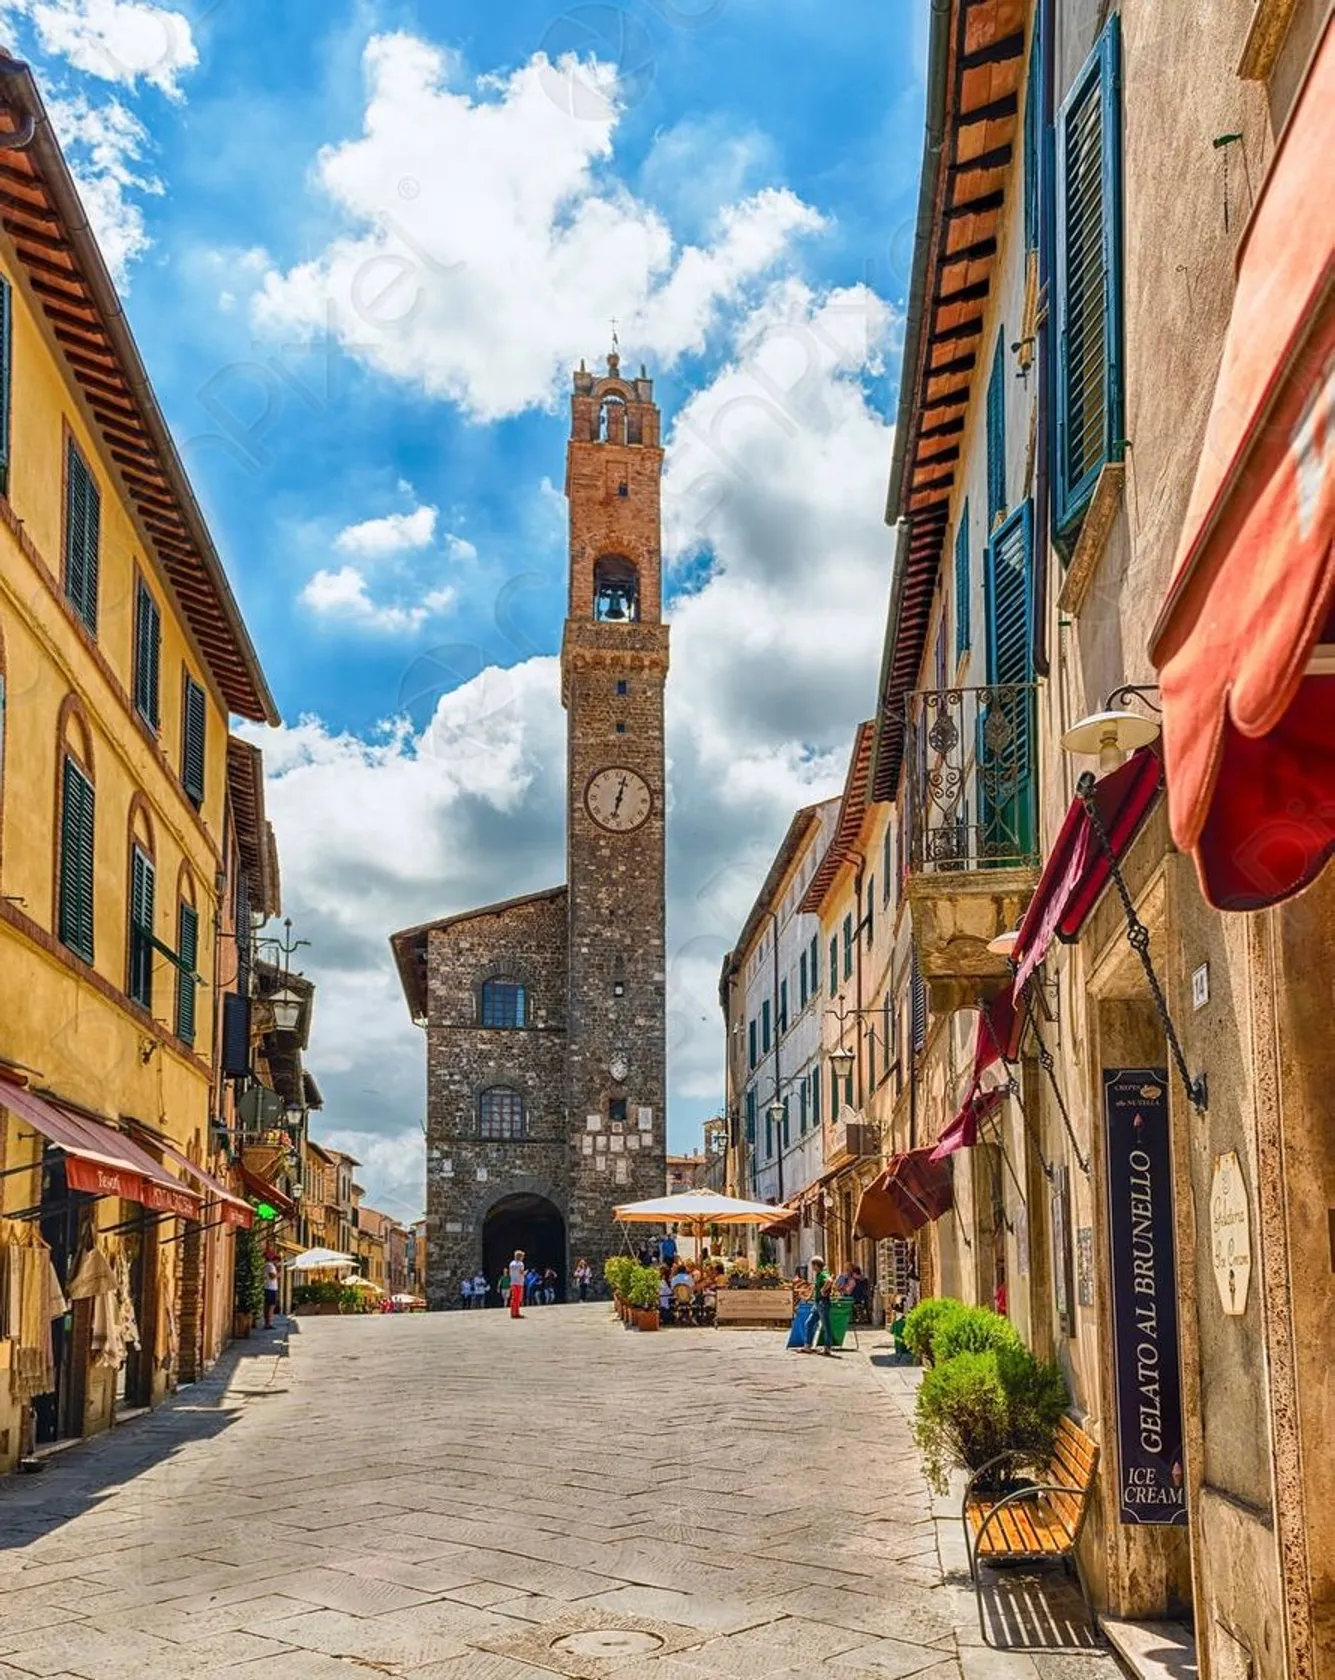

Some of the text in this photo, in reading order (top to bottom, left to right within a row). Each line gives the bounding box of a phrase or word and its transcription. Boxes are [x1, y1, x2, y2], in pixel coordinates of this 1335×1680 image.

[1129, 1150, 1163, 1454] GELATO AL BRUNELLO
[1128, 1467, 1157, 1485] ICE
[1124, 1486, 1184, 1504] CREAM
